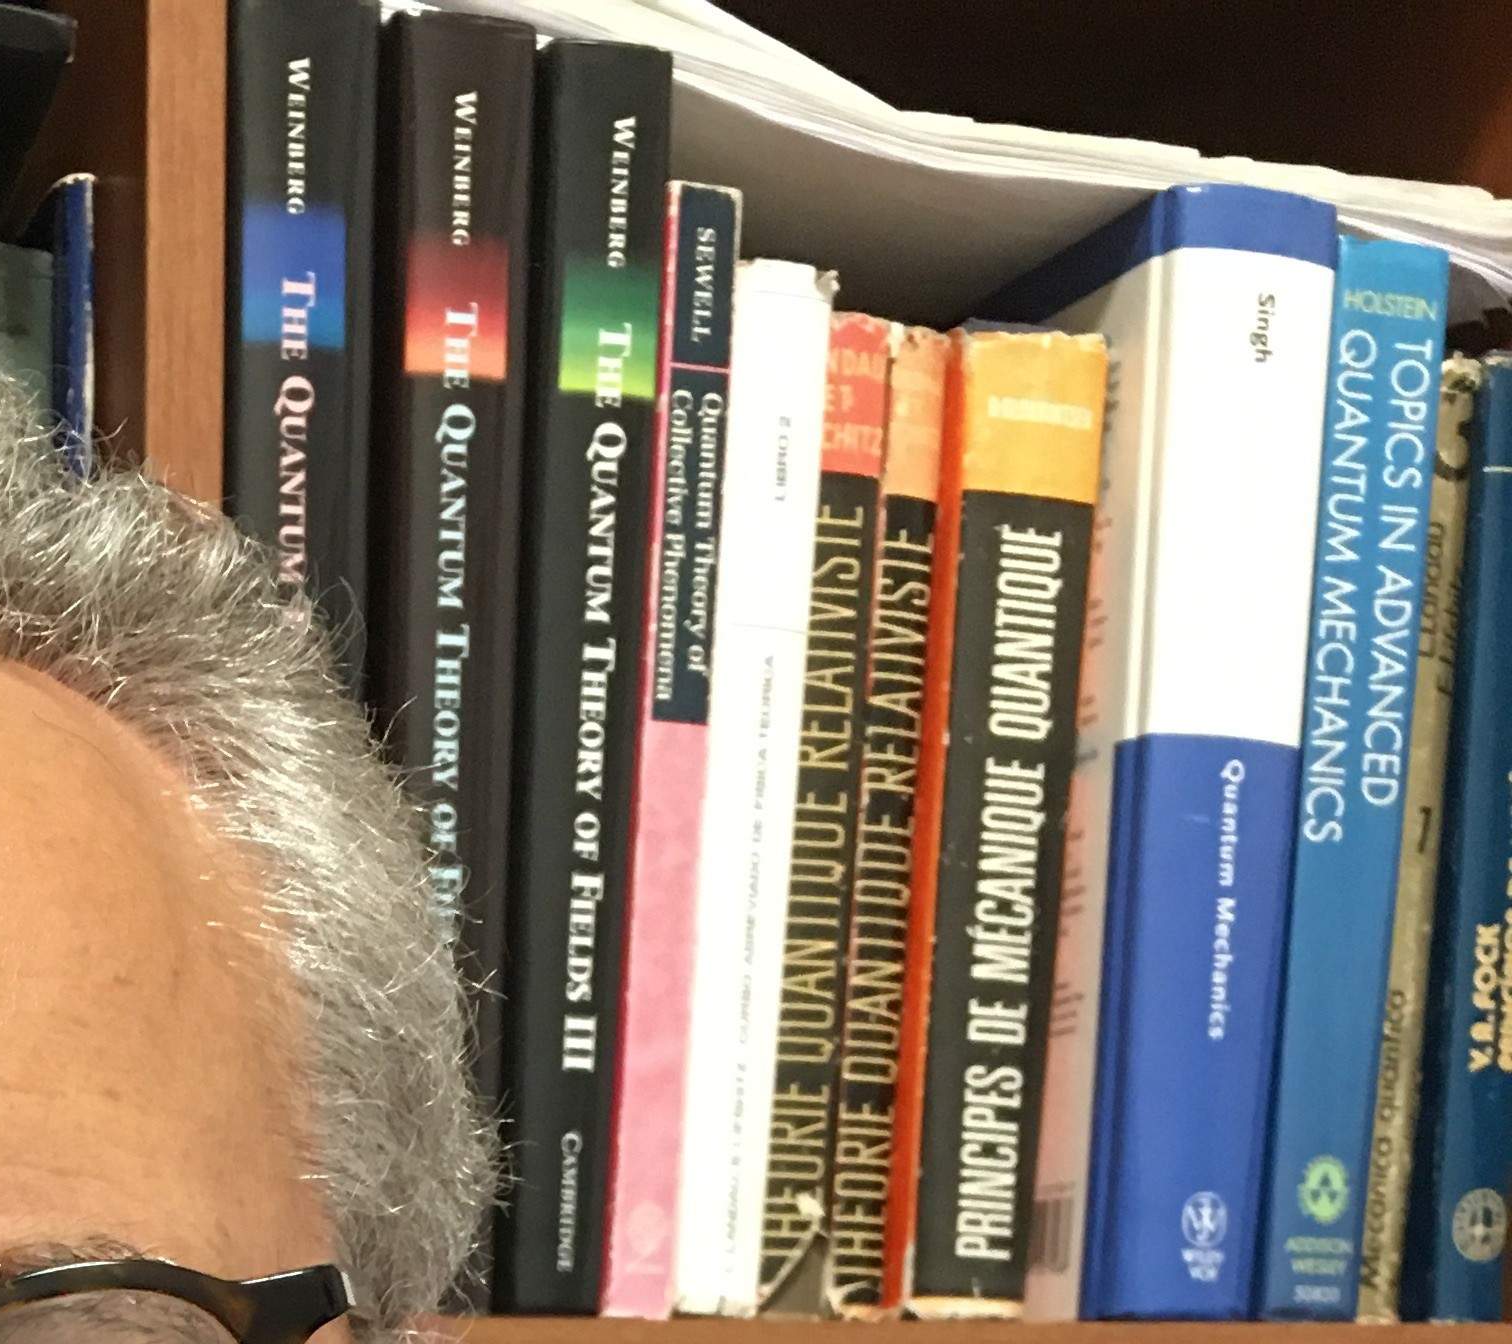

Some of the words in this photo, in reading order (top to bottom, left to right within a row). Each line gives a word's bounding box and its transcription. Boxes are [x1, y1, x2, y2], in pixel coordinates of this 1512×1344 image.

[285, 56, 311, 215] WEINBERG
[451, 91, 477, 247] WEINBERG
[605, 115, 636, 269] WEINBERG
[281, 271, 316, 361] THE
[443, 301, 478, 390] THE
[692, 227, 717, 343] SEWELL
[1249, 293, 1276, 364] Singh
[594, 322, 632, 410] THE
[1382, 339, 1435, 489] TOPICS
[274, 375, 316, 584] QUANTUM
[434, 402, 477, 610] QUANTUM
[665, 389, 694, 522] Collective
[694, 390, 724, 524] Quantum
[1325, 327, 1378, 564] QUANTUM
[584, 421, 628, 625] QUANTUM
[690, 527, 720, 633] Theory
[1378, 505, 1429, 552] IN
[654, 532, 686, 700] Phenomena
[686, 637, 707, 675] of
[988, 523, 1064, 741] QUANTIQUE
[1361, 563, 1415, 808] ADVANCED
[431, 624, 471, 792] THEORY
[573, 639, 616, 802] THEORY
[1303, 575, 1360, 844] MECHANICS
[572, 810, 601, 862] OF
[971, 756, 1047, 985] MÉCANIQUE
[1216, 757, 1246, 888] Quantum
[564, 872, 606, 1004] FIELDS
[1207, 896, 1237, 1041] Mechanics
[562, 1014, 597, 1073] III
[967, 998, 1029, 1046] DE
[557, 1130, 583, 1273] CAMBRIDGE
[955, 1064, 1024, 1262] PRINCIPES
